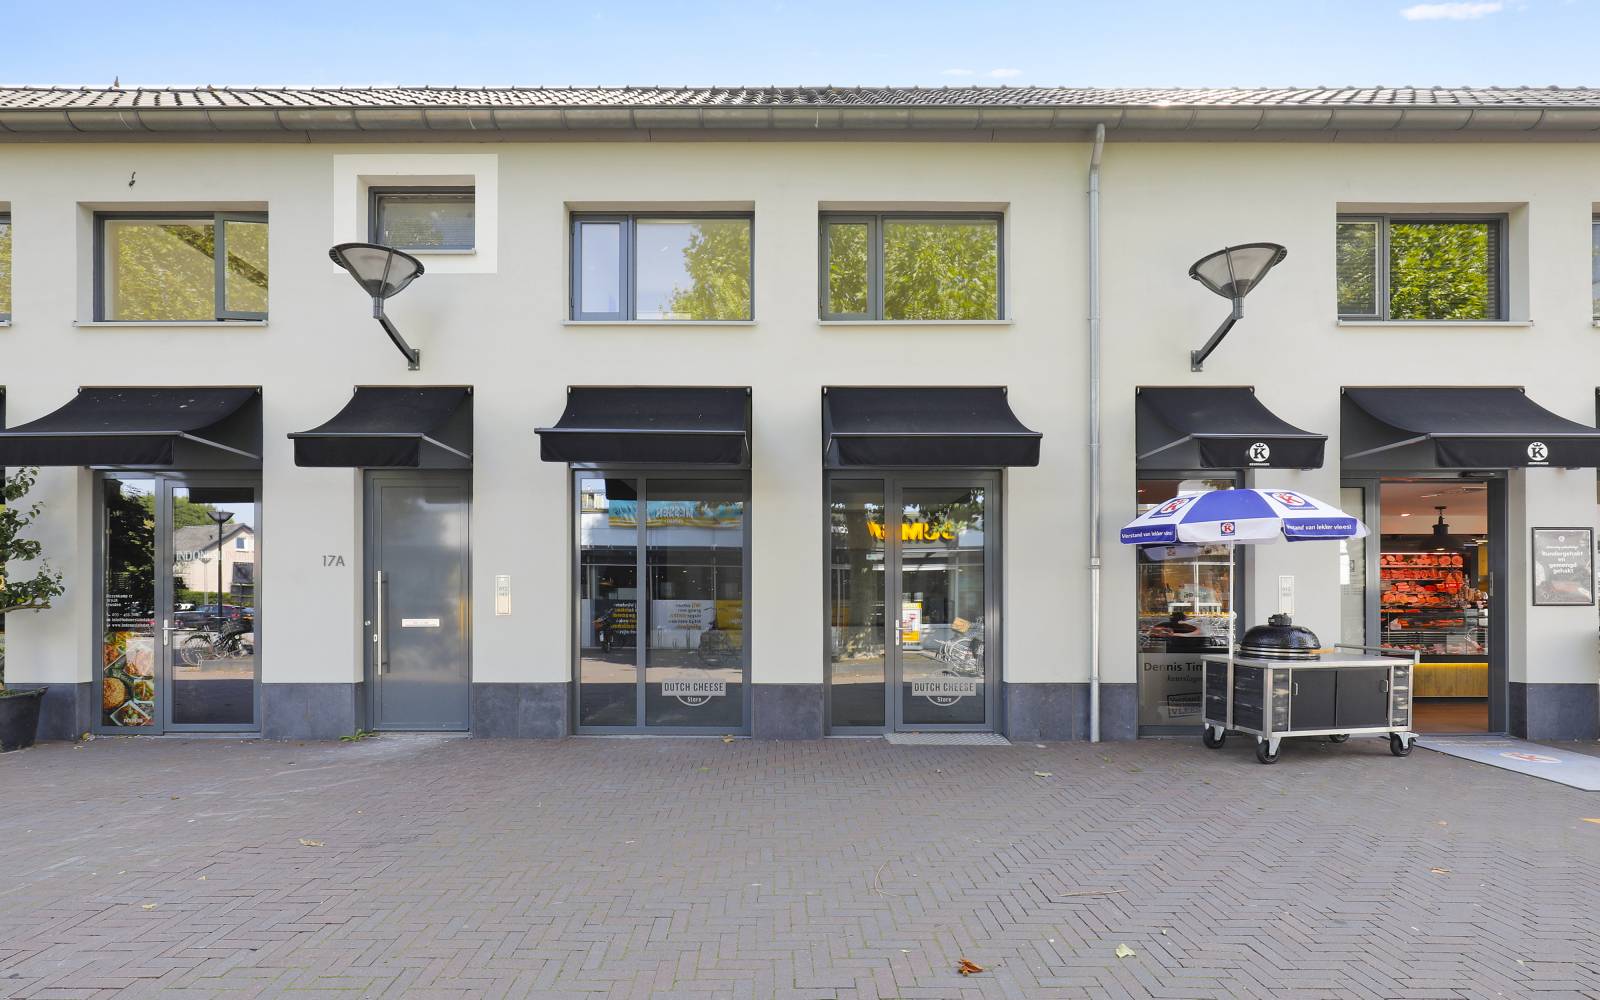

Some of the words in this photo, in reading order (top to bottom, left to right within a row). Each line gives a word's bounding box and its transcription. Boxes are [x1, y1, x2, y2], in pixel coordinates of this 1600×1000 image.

[322, 555, 345, 567] 17A
[1144, 662, 1183, 672] Dennis
[664, 682, 691, 691] DUTCH
[693, 682, 724, 691] CHEESE
[914, 682, 941, 692] DUTCH
[943, 682, 974, 692] CHEESE
